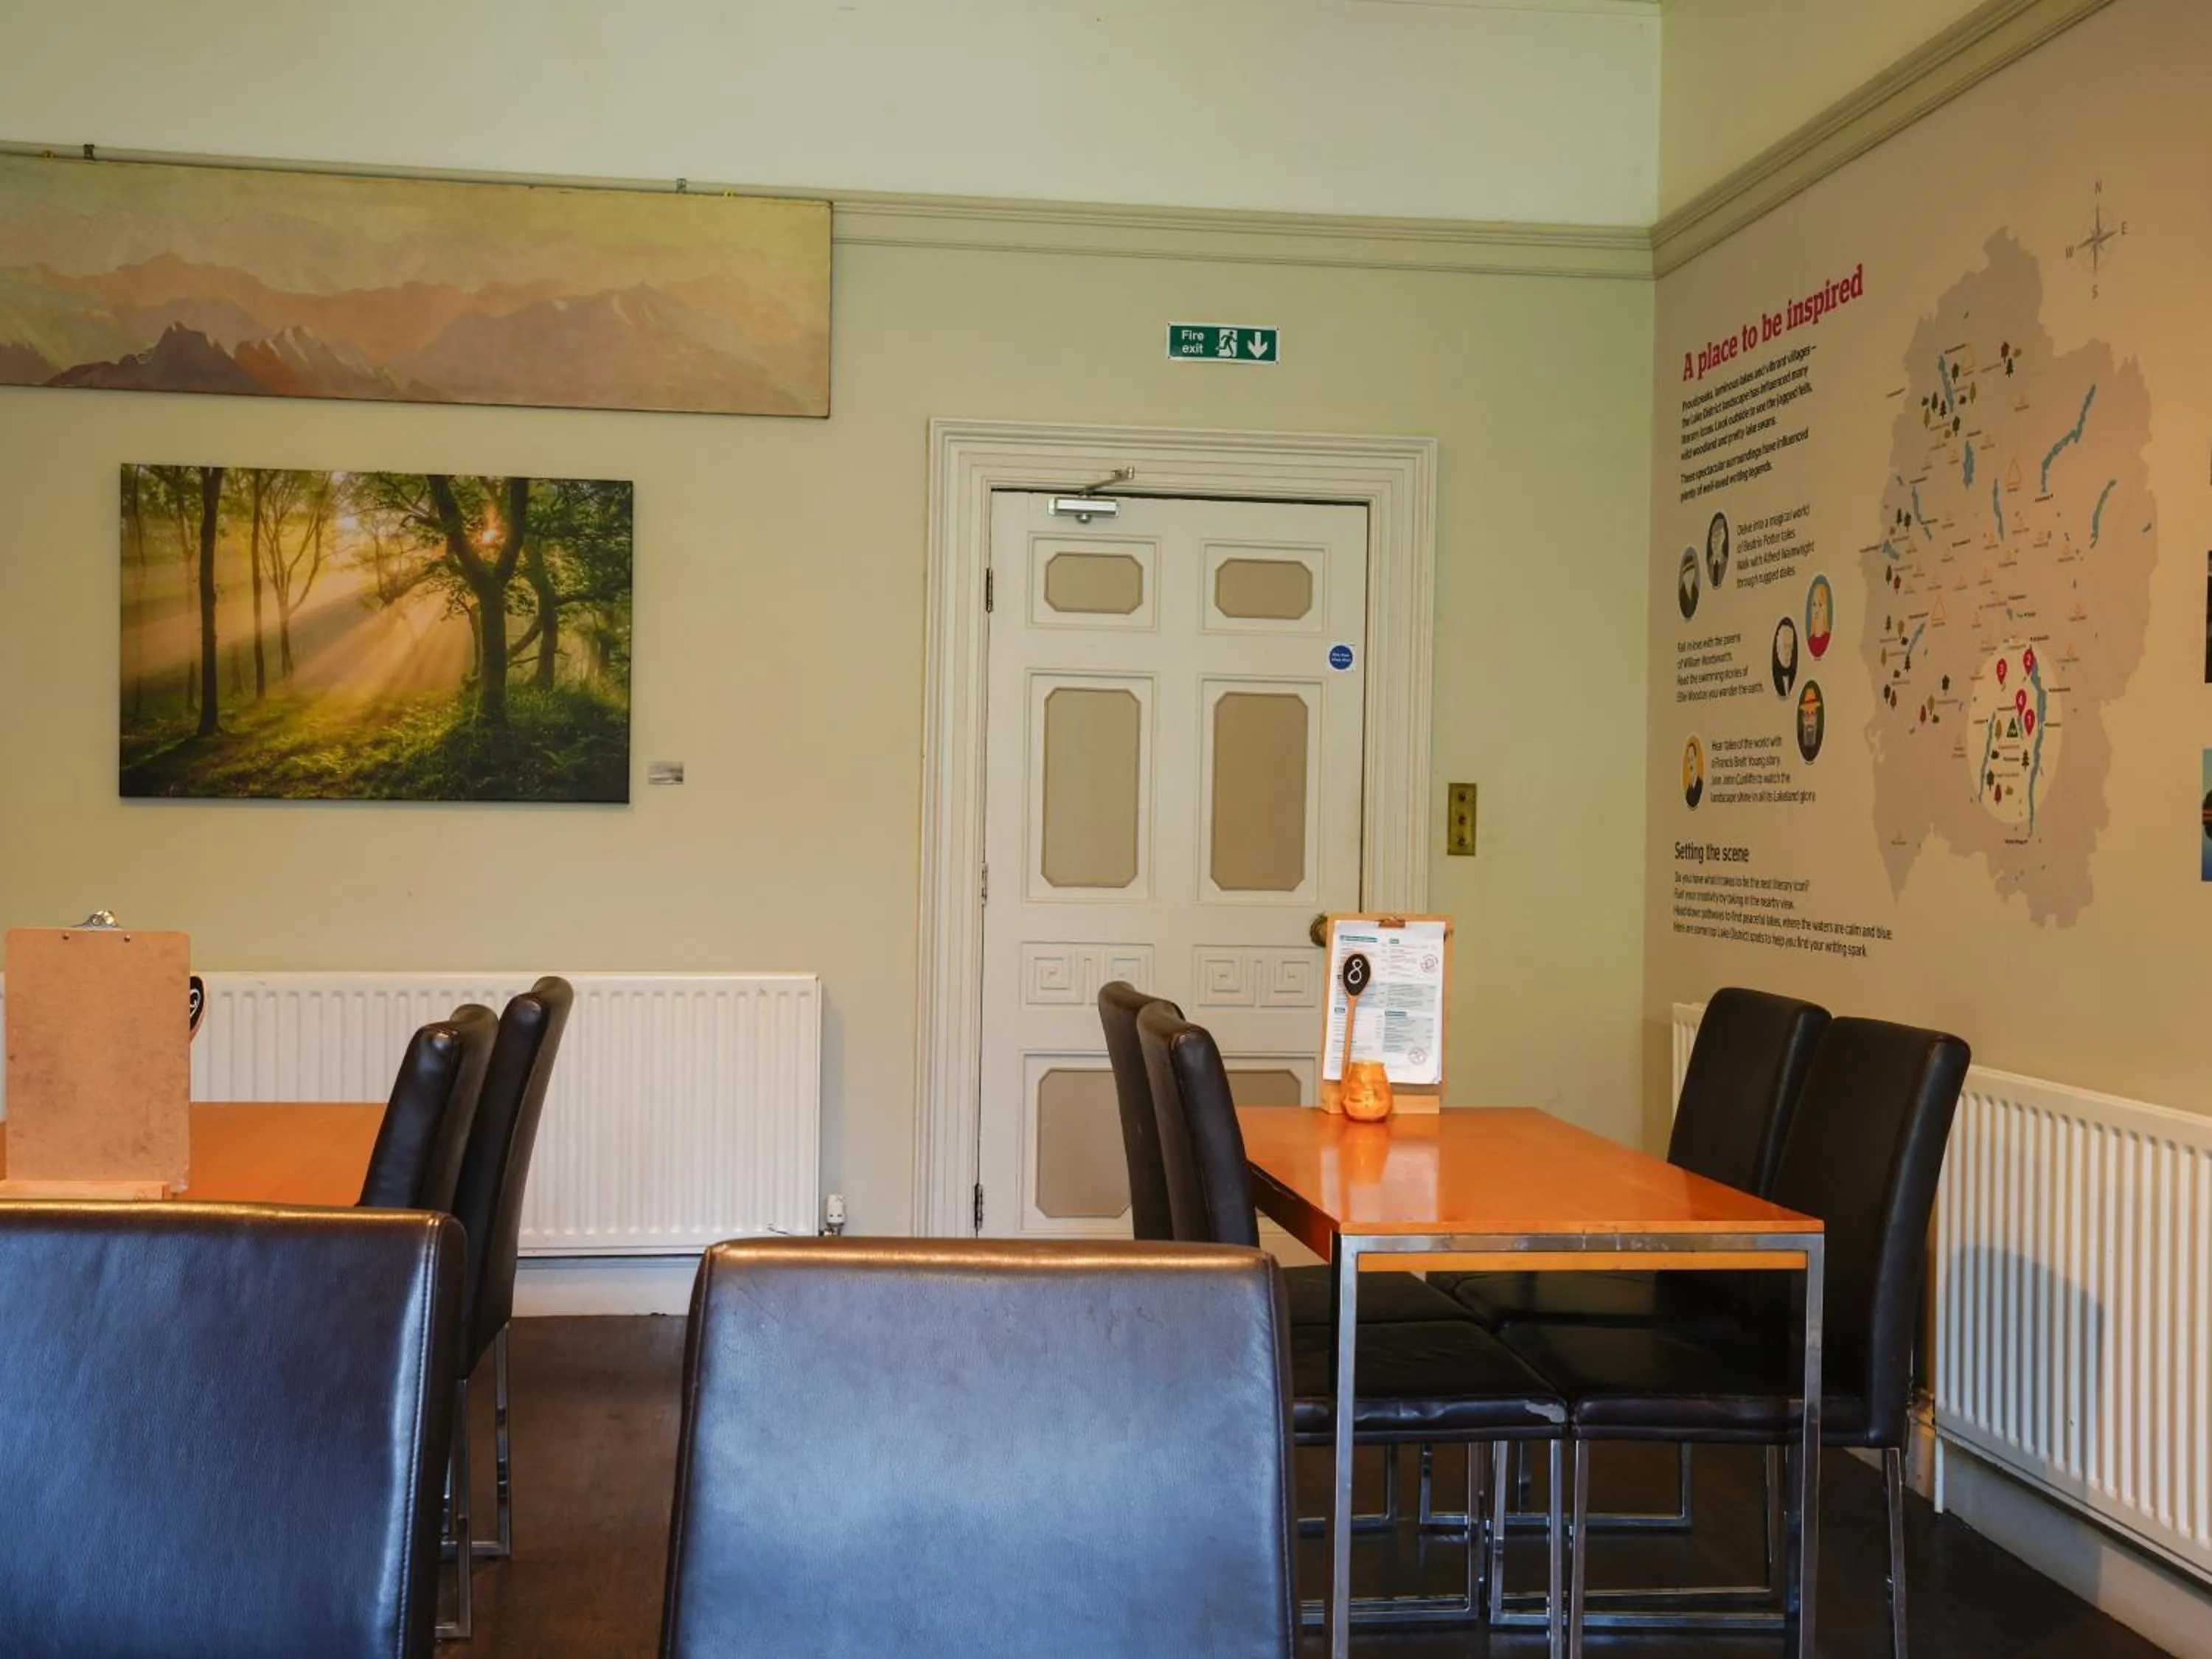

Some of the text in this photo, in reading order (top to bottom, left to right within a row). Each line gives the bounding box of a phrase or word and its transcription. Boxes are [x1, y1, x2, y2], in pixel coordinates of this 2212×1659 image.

[2095, 180, 2102, 195] N
[2121, 221, 2127, 236] E
[2065, 245, 2074, 260] W
[2092, 285, 2098, 299] S
[1683, 263, 1863, 381] A place to be inspired
[1181, 330, 1204, 341] Fire
[1182, 344, 1203, 354] exit
[1674, 842, 1749, 864] Setting the scene
[1348, 959, 1363, 984] 8
